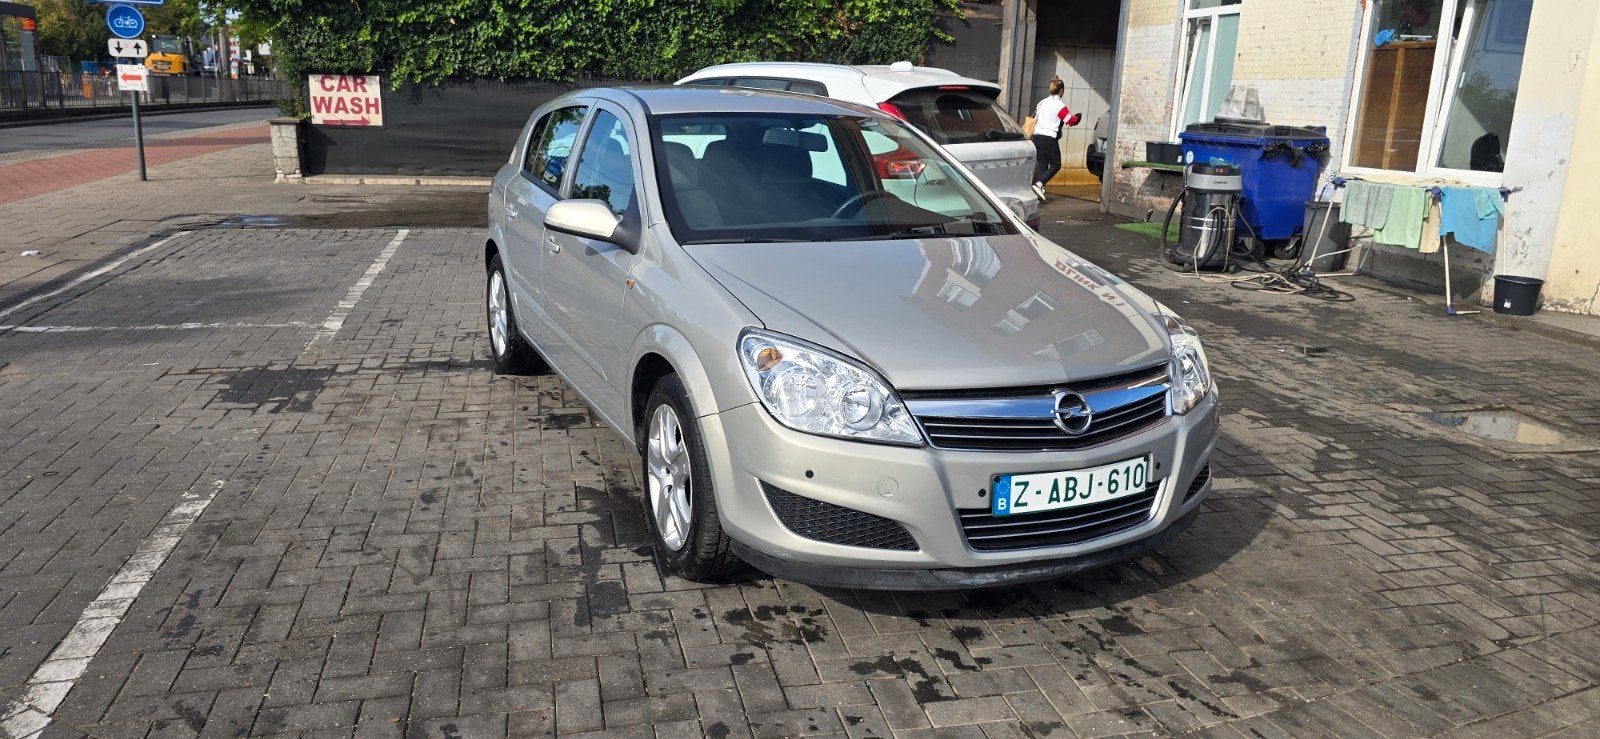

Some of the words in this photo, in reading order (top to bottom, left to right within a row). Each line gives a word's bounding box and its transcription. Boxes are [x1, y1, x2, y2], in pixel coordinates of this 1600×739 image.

[320, 74, 367, 93] CAR
[312, 96, 380, 115] WASH
[1014, 463, 1144, 507] Z-ABJ-610
[998, 498, 1007, 511] B
